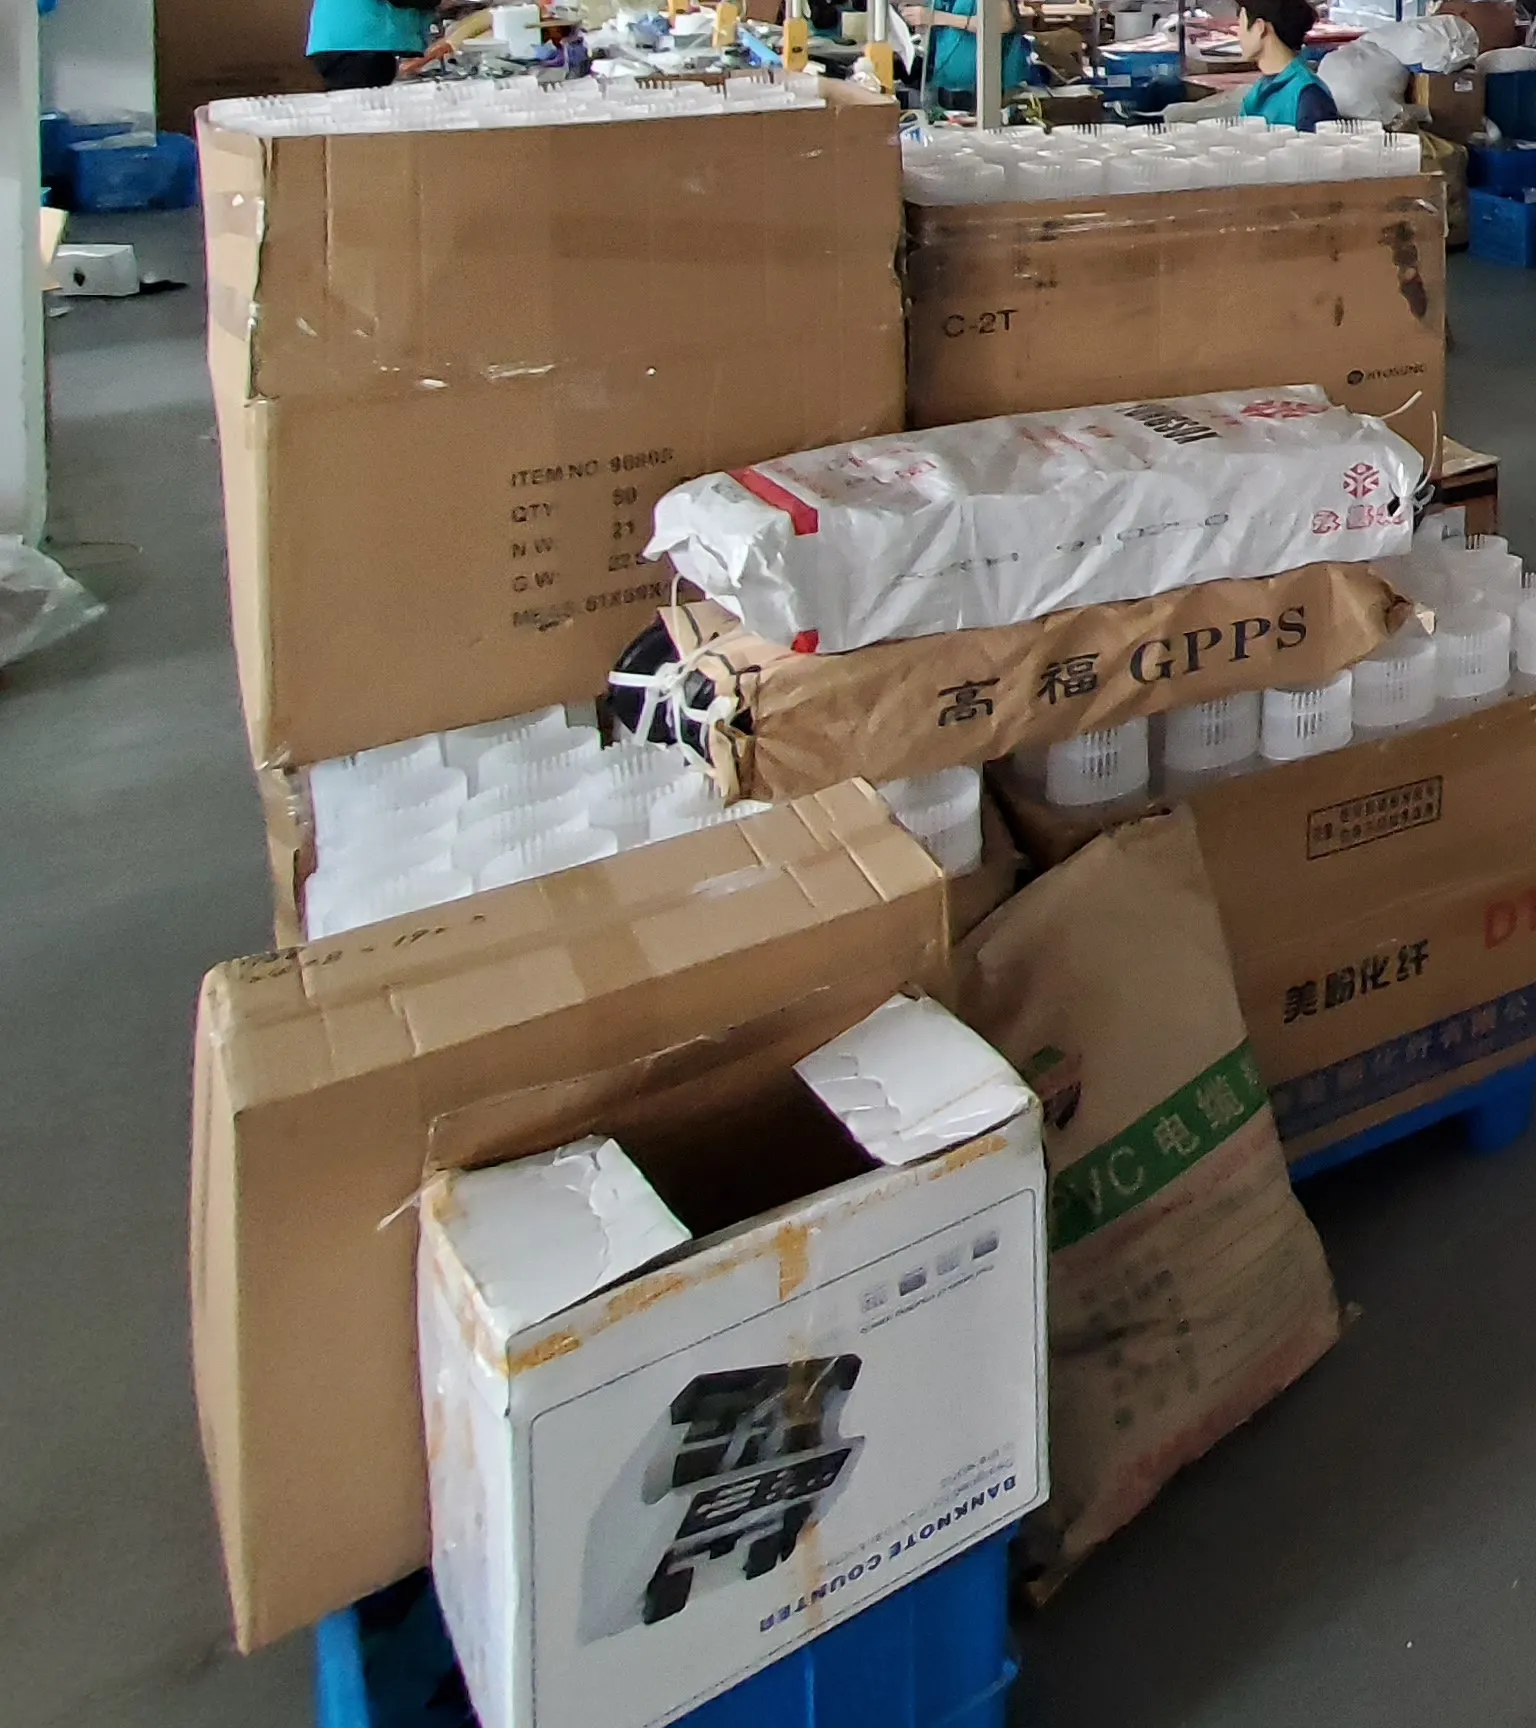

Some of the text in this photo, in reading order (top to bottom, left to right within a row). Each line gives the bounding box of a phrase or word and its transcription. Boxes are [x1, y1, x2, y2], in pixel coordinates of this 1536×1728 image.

[943, 309, 1019, 339] C-2T
[511, 465, 563, 487] ITEM
[937, 605, 1308, 727] 高福 GPPS
[888, 1474, 1017, 1560] BANKNOTE
[760, 1553, 882, 1633] COUNTER
